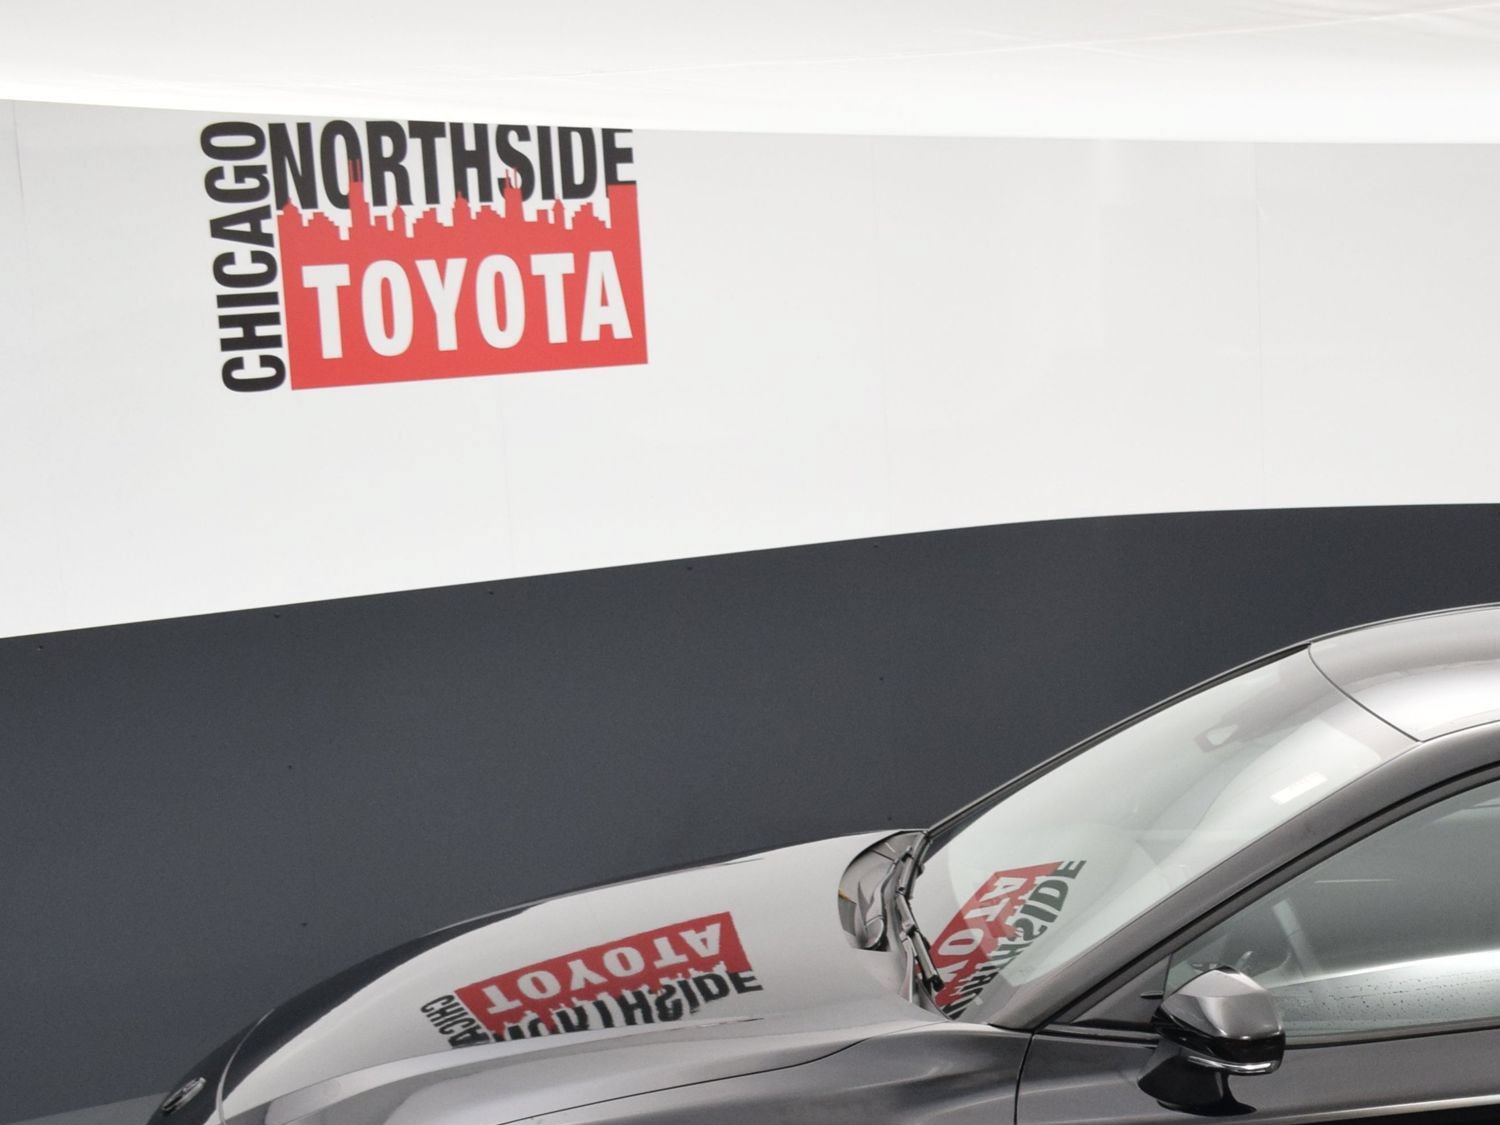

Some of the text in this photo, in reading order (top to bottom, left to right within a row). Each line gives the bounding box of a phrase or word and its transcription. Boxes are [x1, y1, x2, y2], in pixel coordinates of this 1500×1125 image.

[267, 119, 637, 212] NORTHSIDE
[200, 120, 287, 393] CHICAGO
[301, 250, 634, 360] TOYOTA
